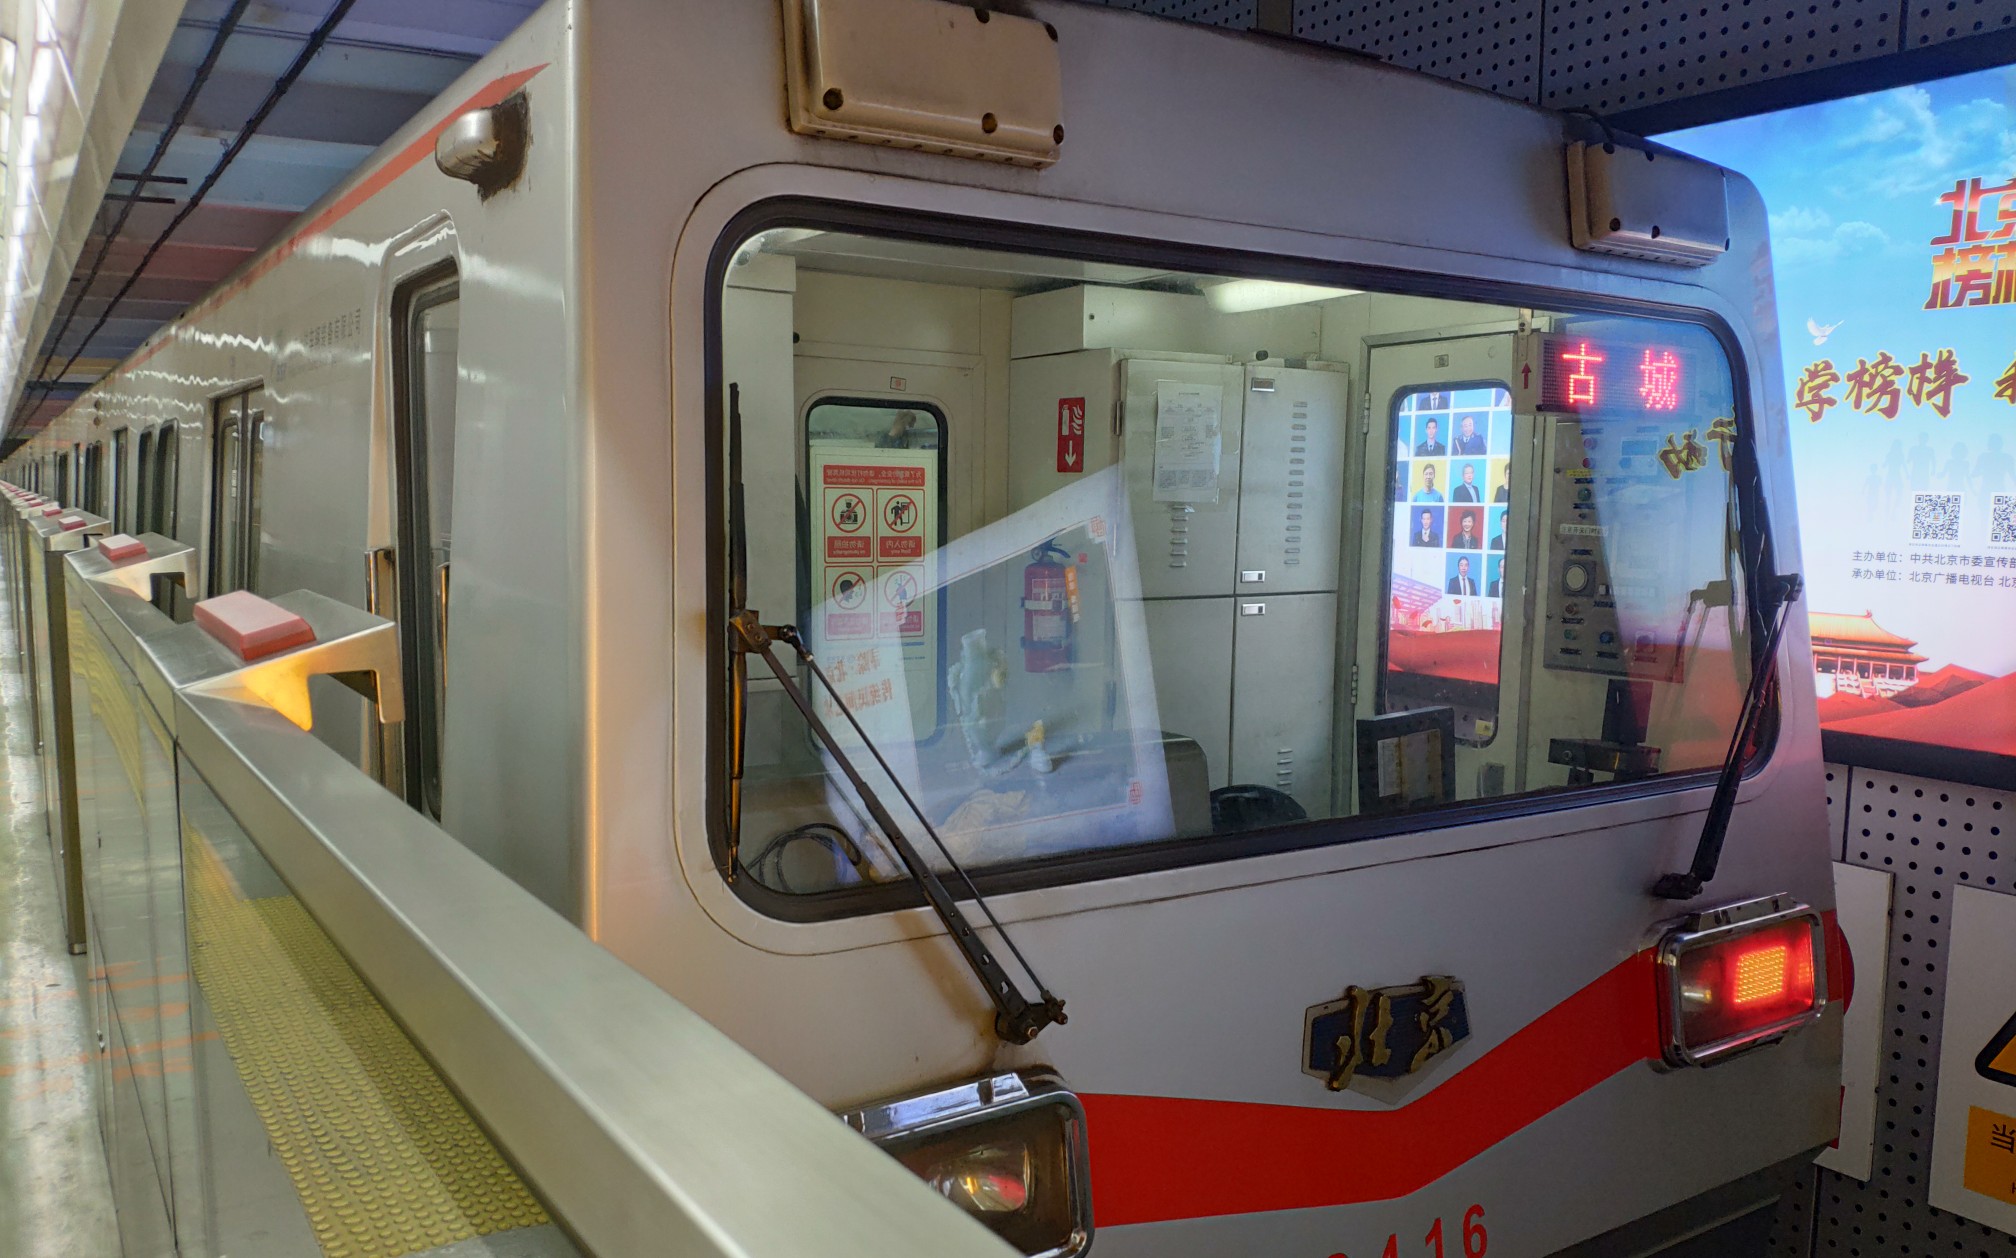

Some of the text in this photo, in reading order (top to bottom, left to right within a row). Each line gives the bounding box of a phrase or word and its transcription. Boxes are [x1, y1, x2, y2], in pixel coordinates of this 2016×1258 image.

[1562, 343, 1677, 410] 古城
[1795, 348, 1970, 424] 学榜样
[1991, 1123, 2016, 1154] 当
